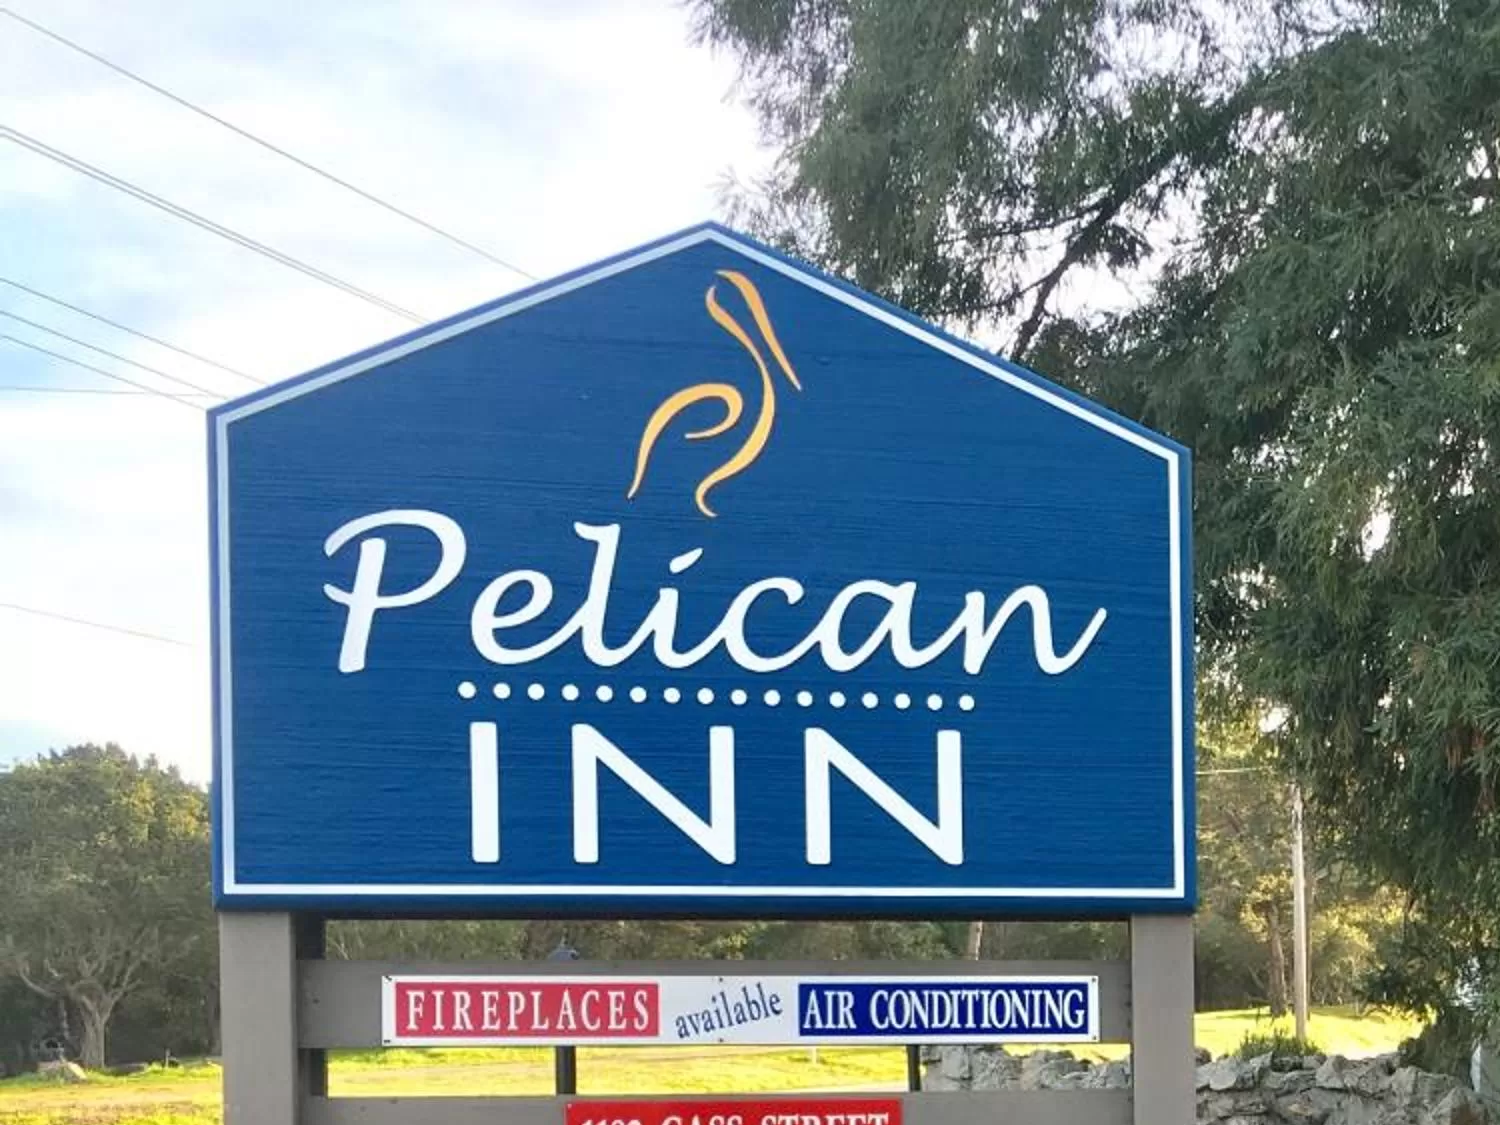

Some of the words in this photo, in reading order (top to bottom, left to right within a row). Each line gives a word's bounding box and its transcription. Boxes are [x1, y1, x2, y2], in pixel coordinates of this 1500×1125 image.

[322, 508, 1107, 675] Pelican
[469, 720, 964, 866] INN
[405, 988, 650, 1032] FIREPLACES
[674, 982, 784, 1039] available
[802, 988, 857, 1030] AIR
[869, 988, 1085, 1031] CONDITIONING
